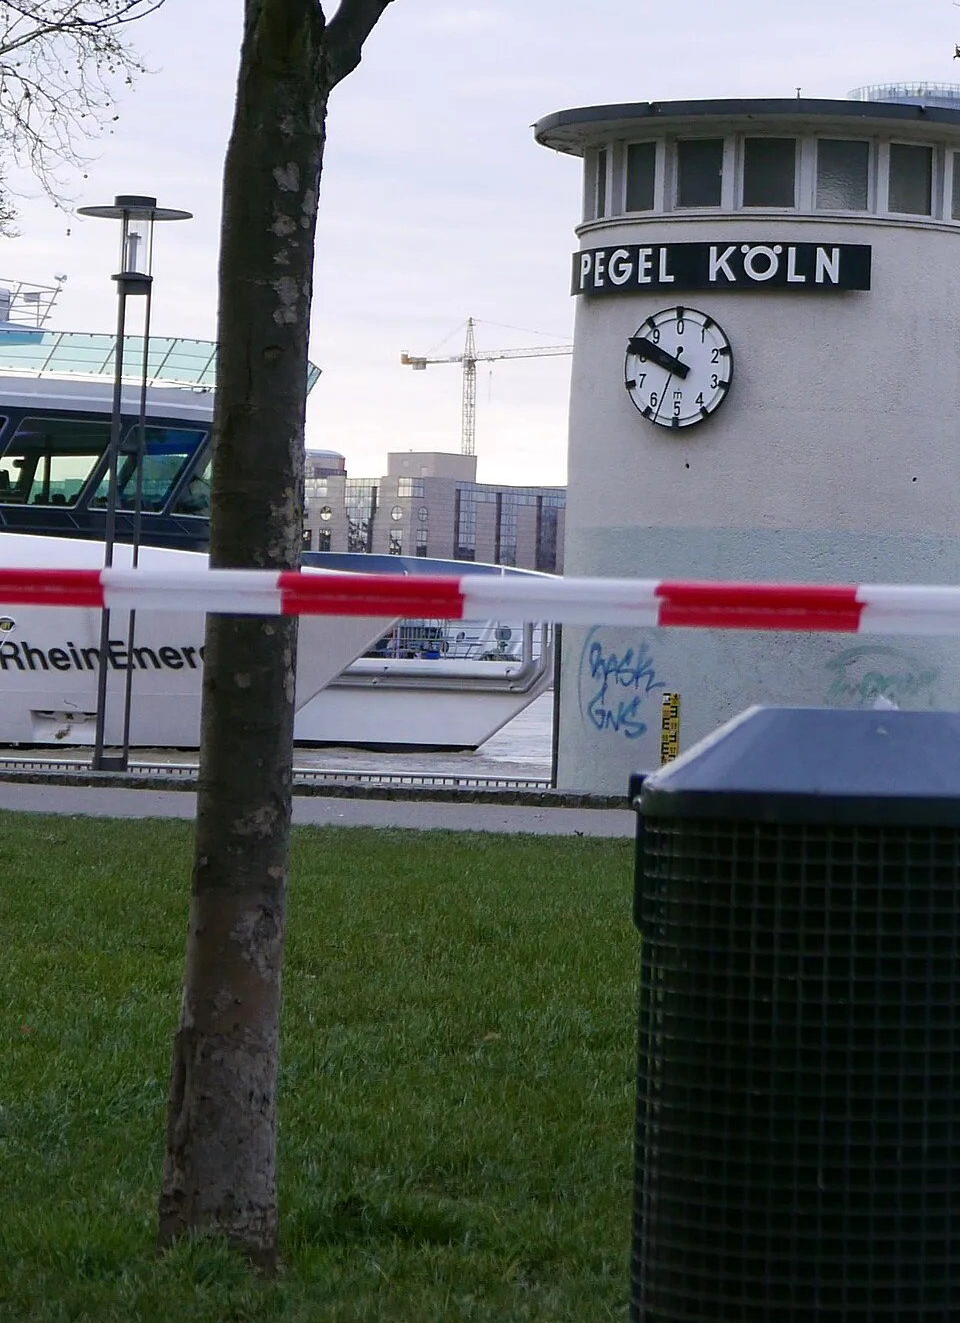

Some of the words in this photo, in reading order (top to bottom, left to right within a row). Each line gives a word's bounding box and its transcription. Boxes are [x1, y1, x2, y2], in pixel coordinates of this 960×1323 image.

[579, 247, 675, 289] PEGEL
[708, 244, 840, 284] KÖLN
[677, 319, 685, 335] 0
[652, 328, 661, 344] 9
[701, 328, 706, 344] 1
[710, 348, 719, 364] 2
[638, 373, 647, 389] 7
[710, 374, 719, 389] 3
[650, 392, 658, 407] 6
[695, 392, 704, 406] 4
[673, 401, 681, 416] 5
[0, 640, 206, 671] RheinEner
